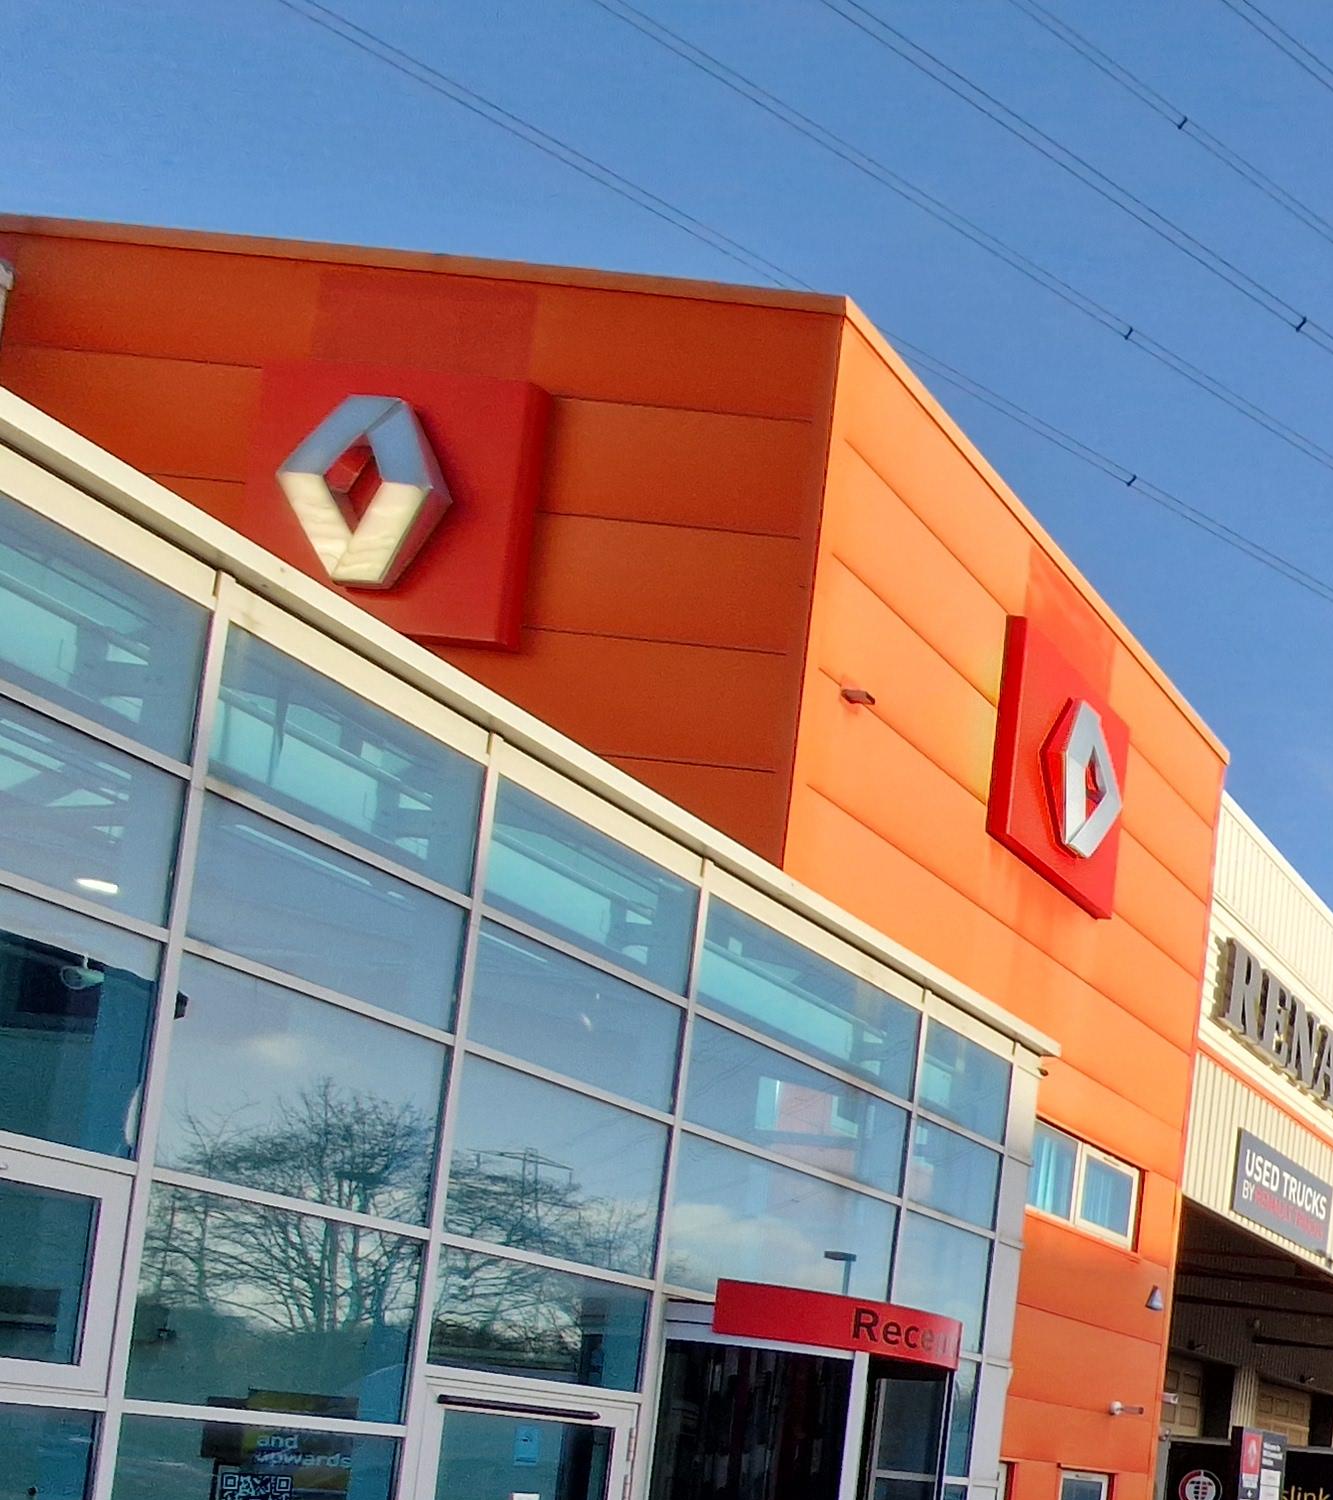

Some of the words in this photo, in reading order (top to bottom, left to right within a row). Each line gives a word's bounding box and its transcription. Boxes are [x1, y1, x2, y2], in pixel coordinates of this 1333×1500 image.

[1242, 1179, 1256, 1202] BY
[1244, 1149, 1280, 1192] USED
[1282, 1171, 1328, 1221] TRUCKS
[256, 1434, 299, 1449] and
